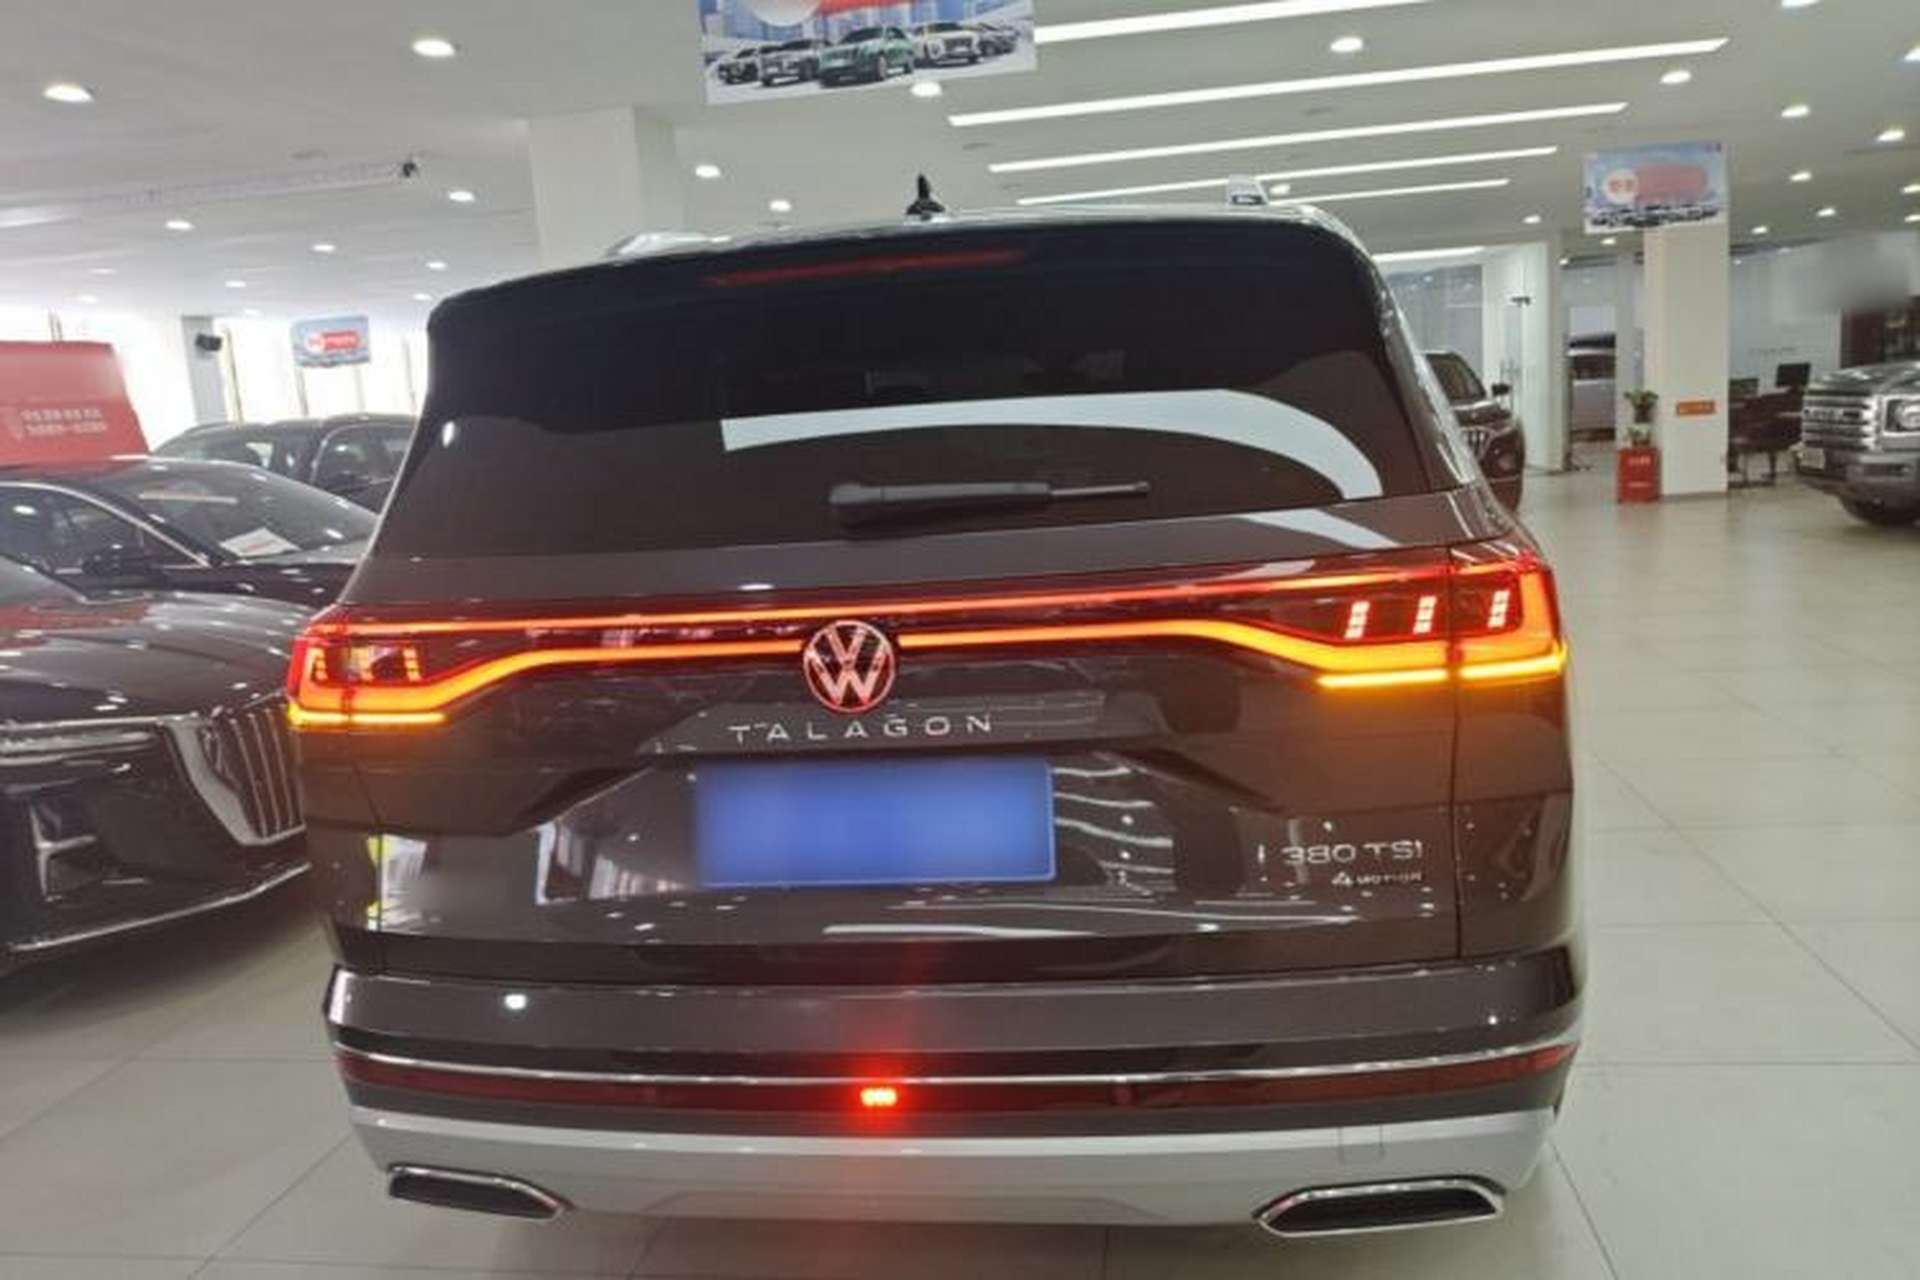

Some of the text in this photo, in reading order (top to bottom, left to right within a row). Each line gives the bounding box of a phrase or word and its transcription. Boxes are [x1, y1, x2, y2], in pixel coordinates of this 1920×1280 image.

[728, 714, 992, 743] TALAGON
[1282, 839, 1422, 864] 380 TSI
